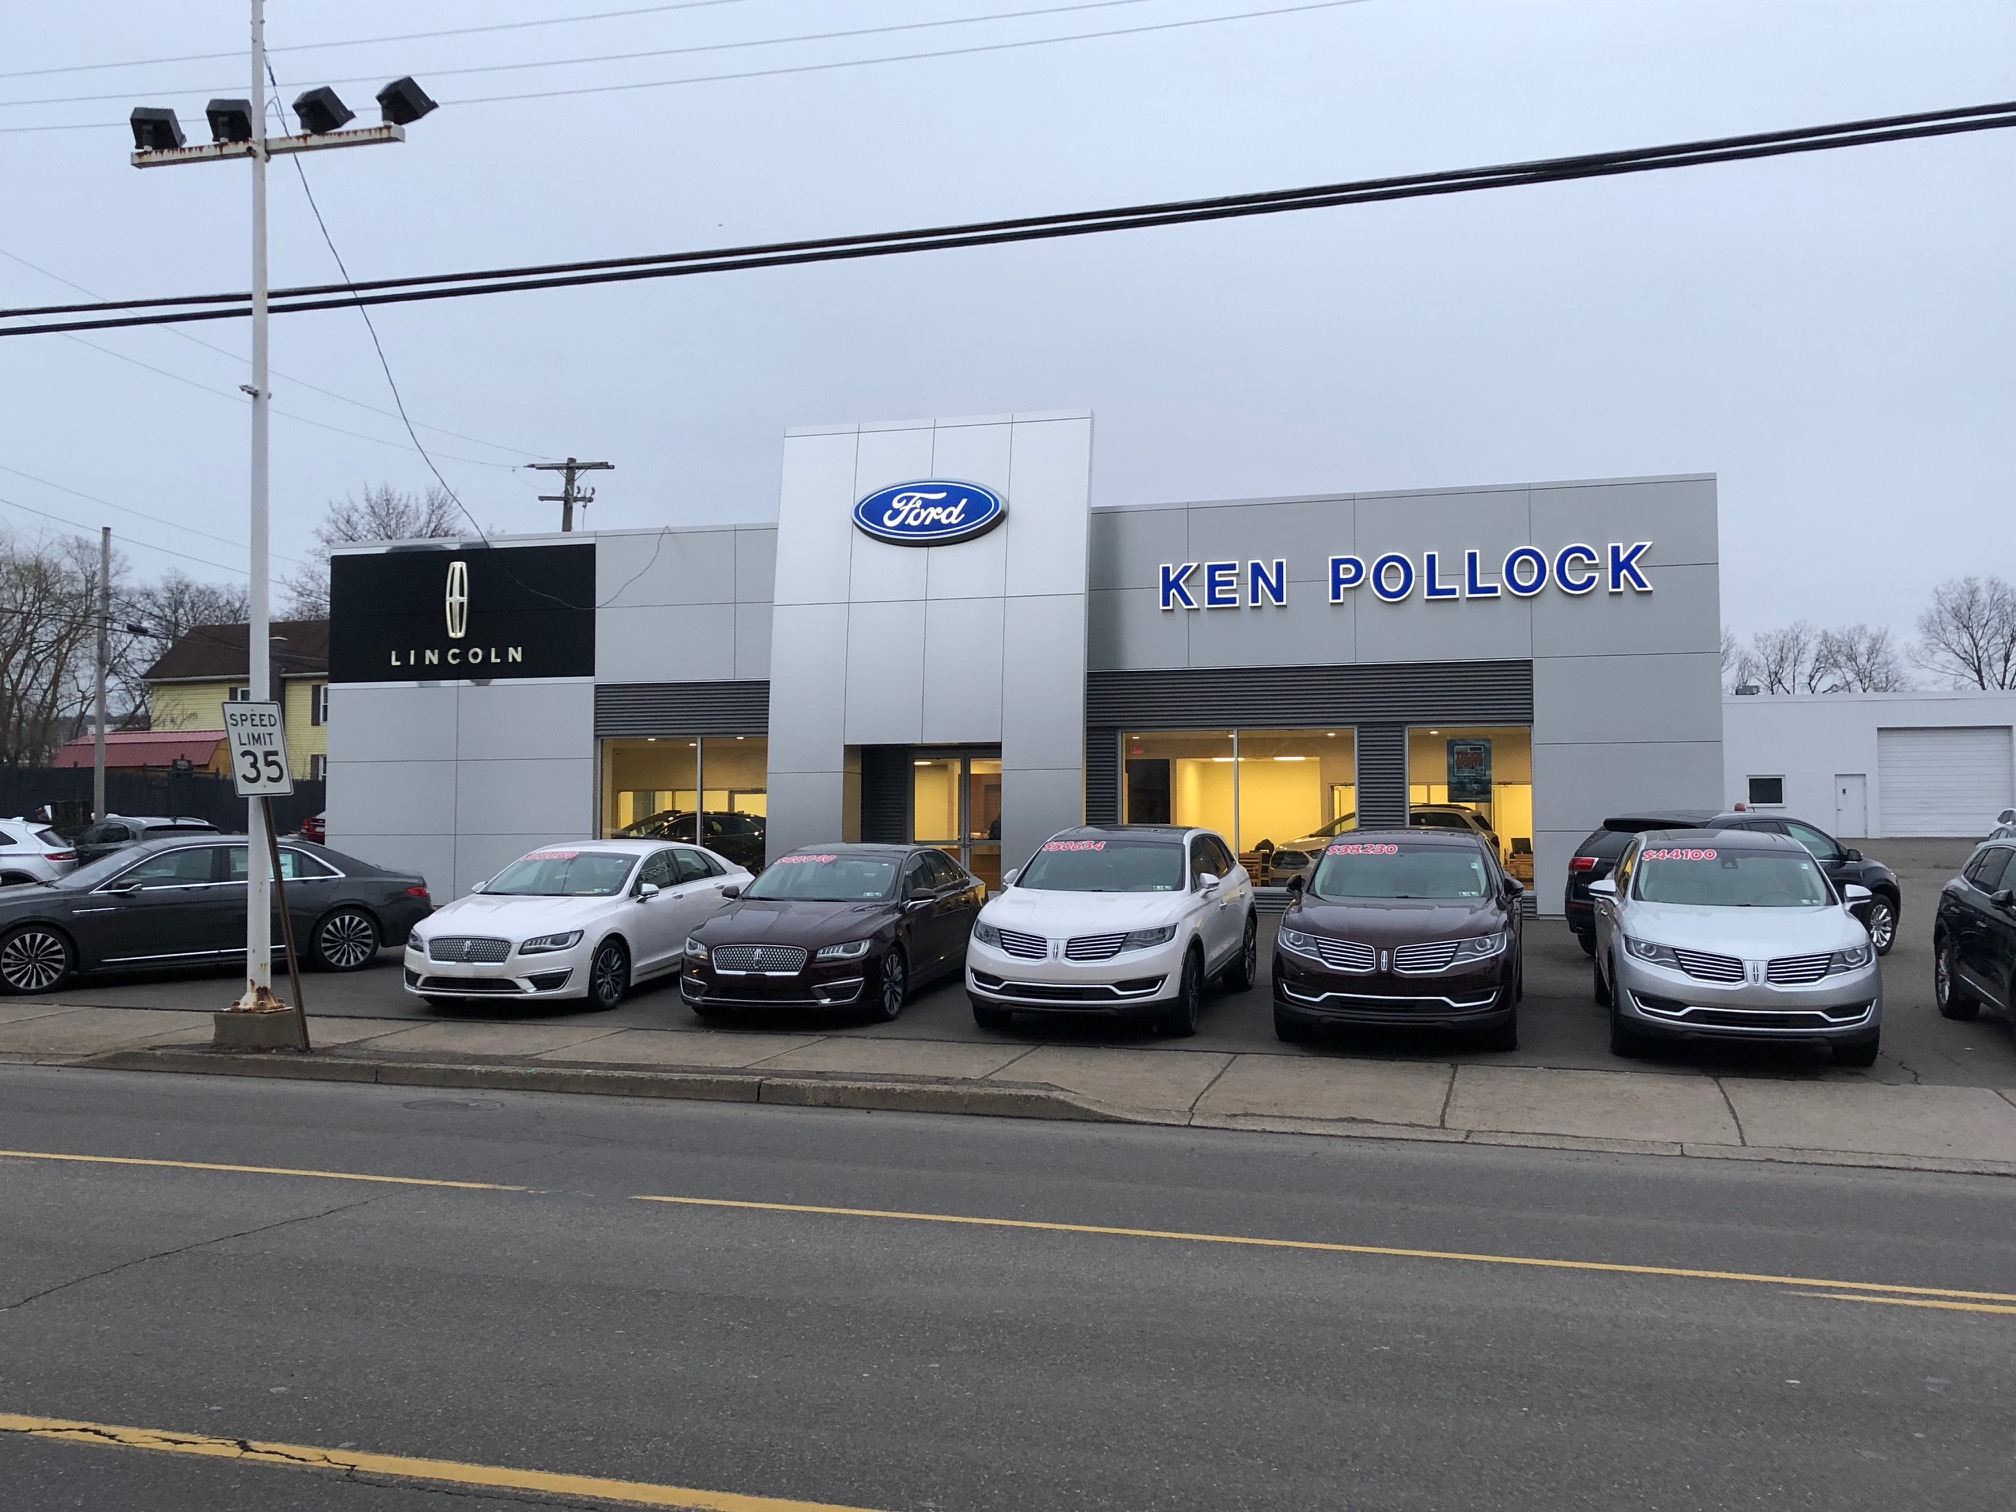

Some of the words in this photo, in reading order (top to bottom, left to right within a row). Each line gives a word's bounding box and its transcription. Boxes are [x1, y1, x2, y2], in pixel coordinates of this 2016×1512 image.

[882, 491, 968, 527] Ford
[1160, 558, 1288, 610] KEN
[1328, 541, 1654, 603] POLLOCK
[390, 646, 522, 666] LINCOLN
[229, 713, 277, 727] SPEED
[238, 732, 274, 746] LIMIT
[240, 750, 284, 783] 35
[1326, 844, 1398, 856] $38230
[1642, 848, 1717, 861] $44100
